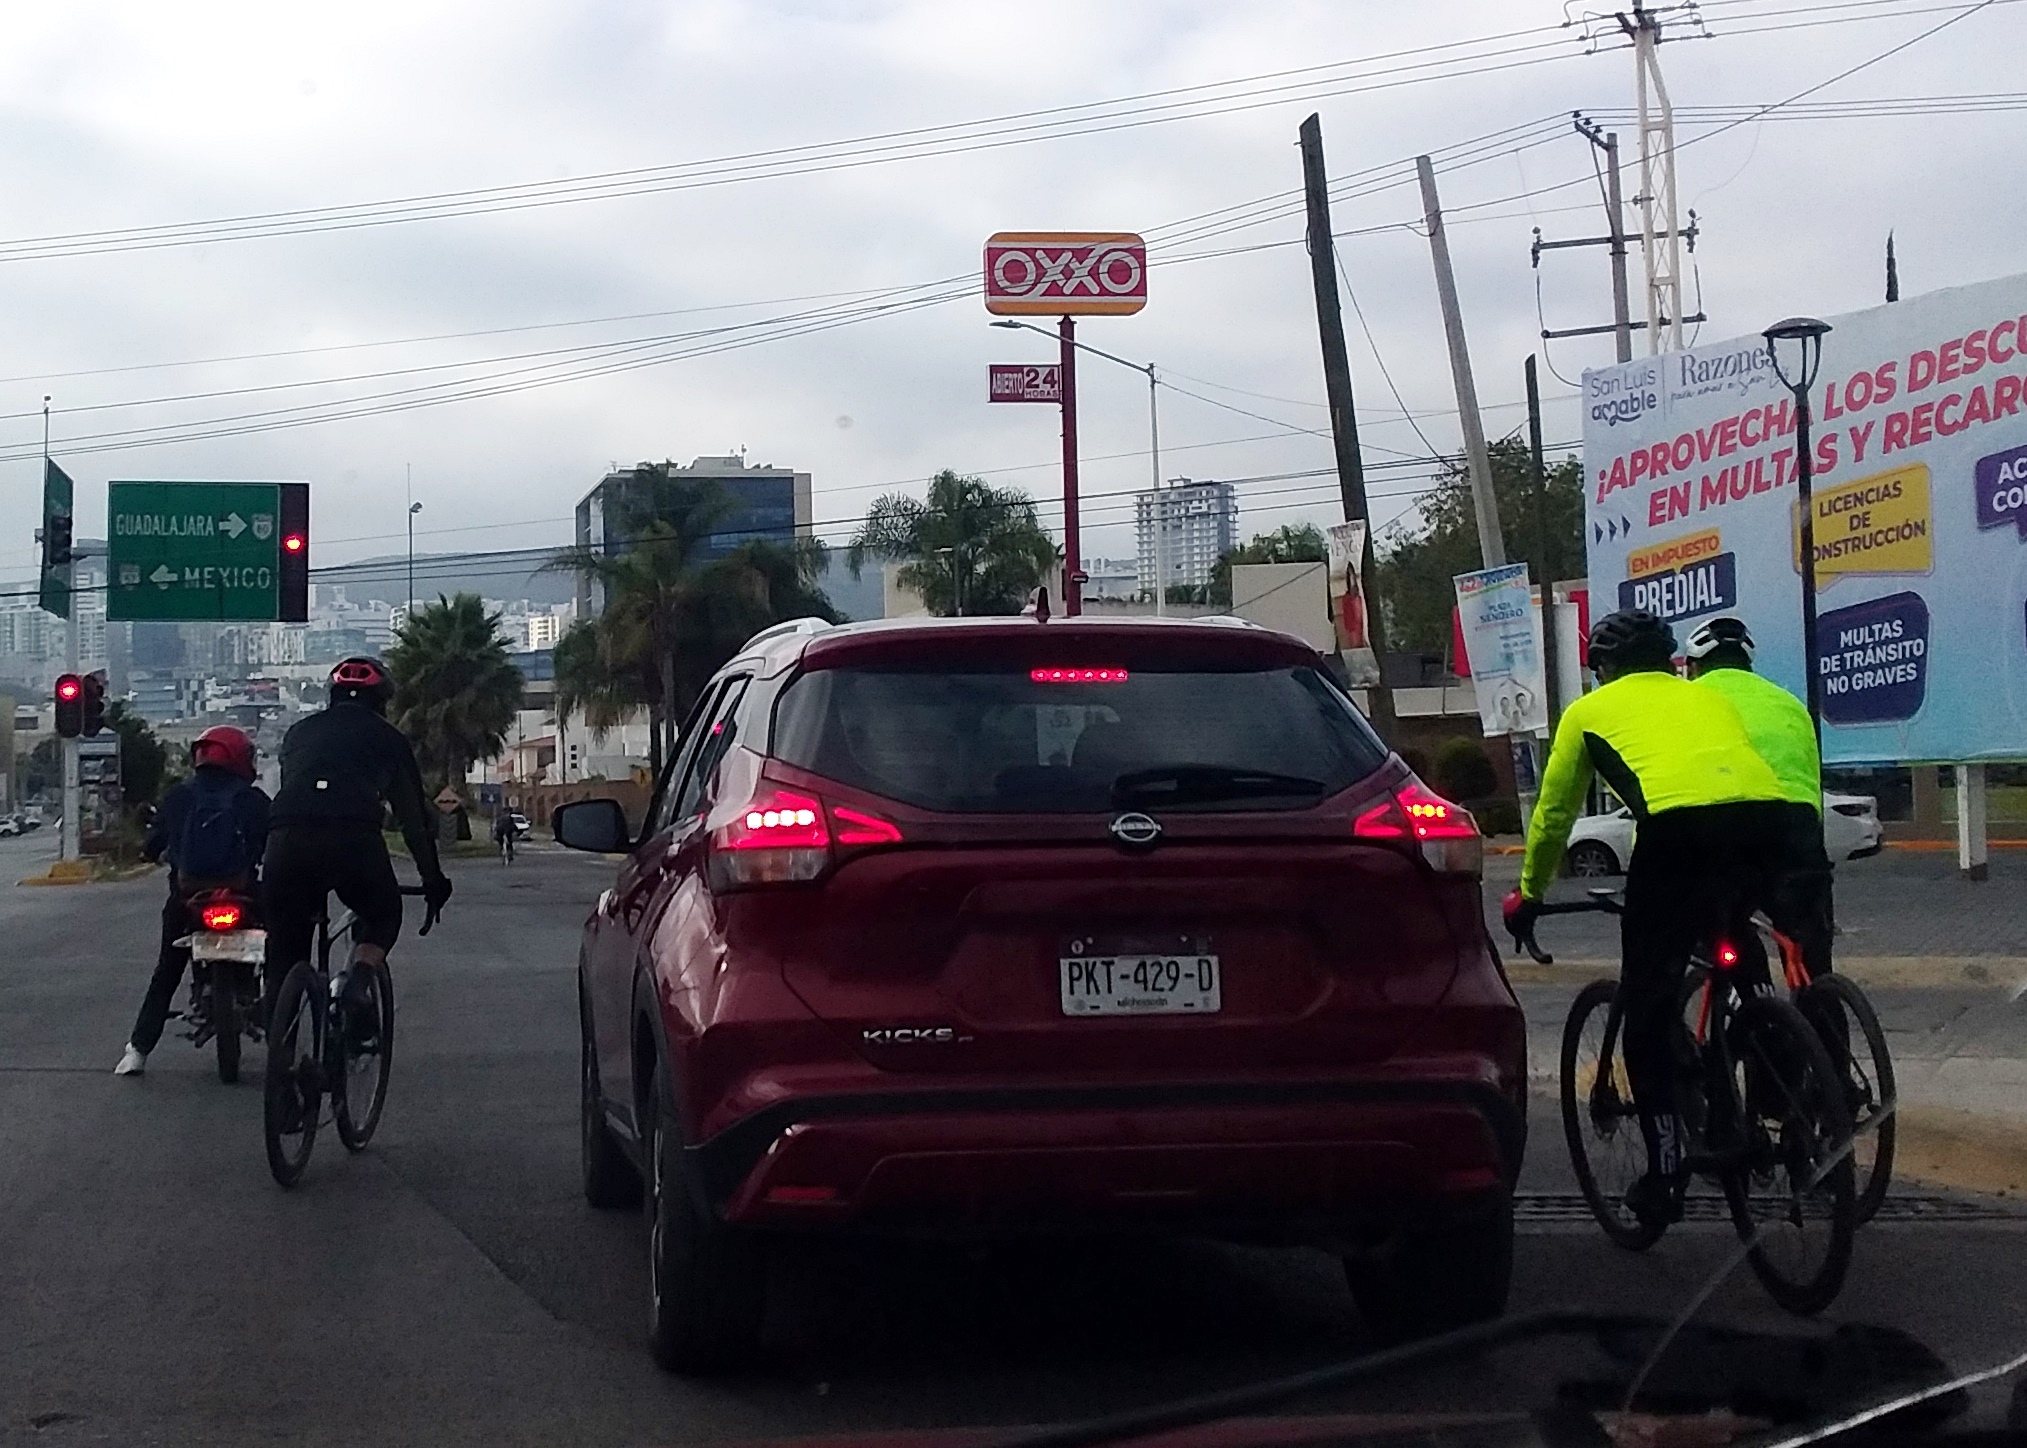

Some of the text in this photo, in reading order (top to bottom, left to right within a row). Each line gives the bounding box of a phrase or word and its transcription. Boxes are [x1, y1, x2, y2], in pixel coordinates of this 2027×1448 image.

[994, 250, 1141, 295] OXXO
[992, 367, 1058, 395] ABIERTO 24
[1591, 369, 1656, 399] San Luis
[1823, 361, 1898, 422] LOS
[1591, 391, 1657, 427] amable
[1648, 375, 2027, 528] EN MULTAS Y RECAR
[1819, 480, 1904, 518] LICENCIAS
[1992, 483, 2027, 513] CO
[116, 513, 215, 537] GUADALAJARA
[1849, 511, 1872, 532] DE
[1631, 535, 1720, 574] EN IMPUESTO
[1803, 518, 1926, 563] ONSTRUCCIÓN
[184, 566, 272, 590] MEXICO
[1634, 564, 1723, 618] PREDIAL
[1479, 608, 1524, 623] SENDERO
[1840, 619, 1904, 649] MULTAS
[1820, 638, 1925, 675] DE TRÁNSITO
[1826, 662, 1918, 696] NO GRAVES
[1067, 958, 1213, 996] PKT-429-D
[862, 1027, 954, 1044] KICKS
